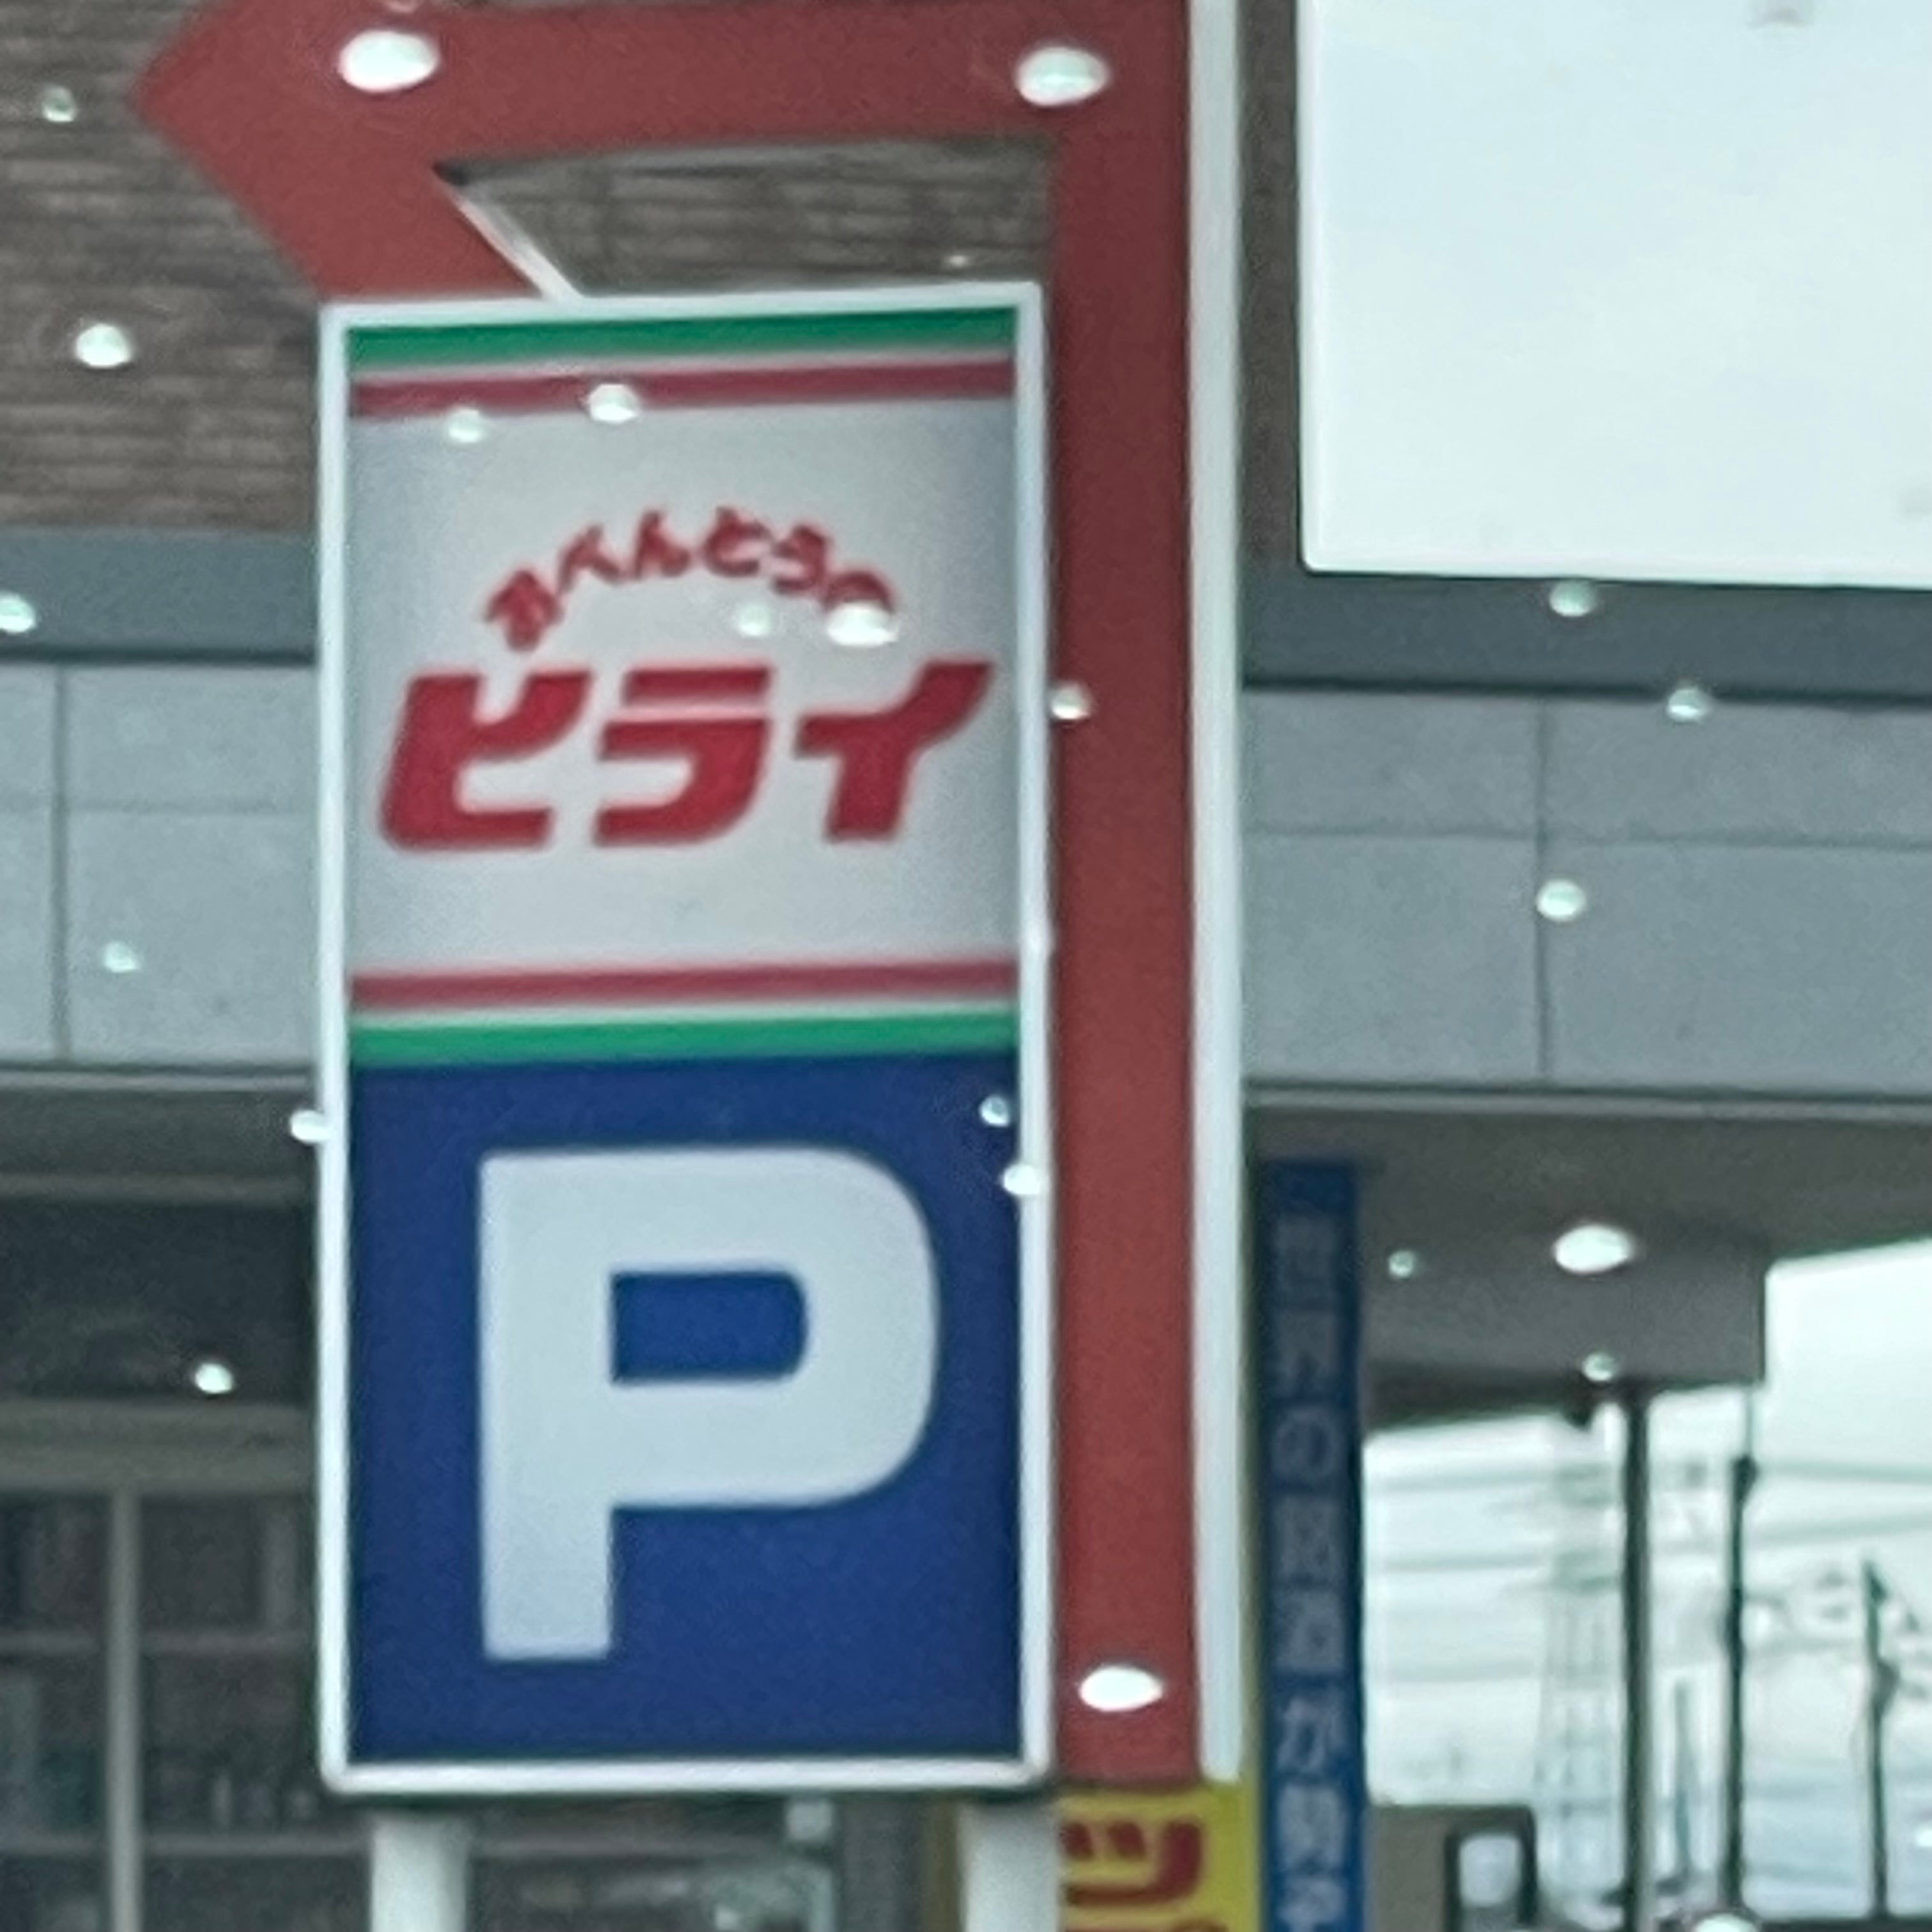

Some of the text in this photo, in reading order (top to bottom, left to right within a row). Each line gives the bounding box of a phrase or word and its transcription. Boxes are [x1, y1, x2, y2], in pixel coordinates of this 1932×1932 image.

[379, 661, 993, 852] ヒライ
[478, 1147, 938, 1660] P
